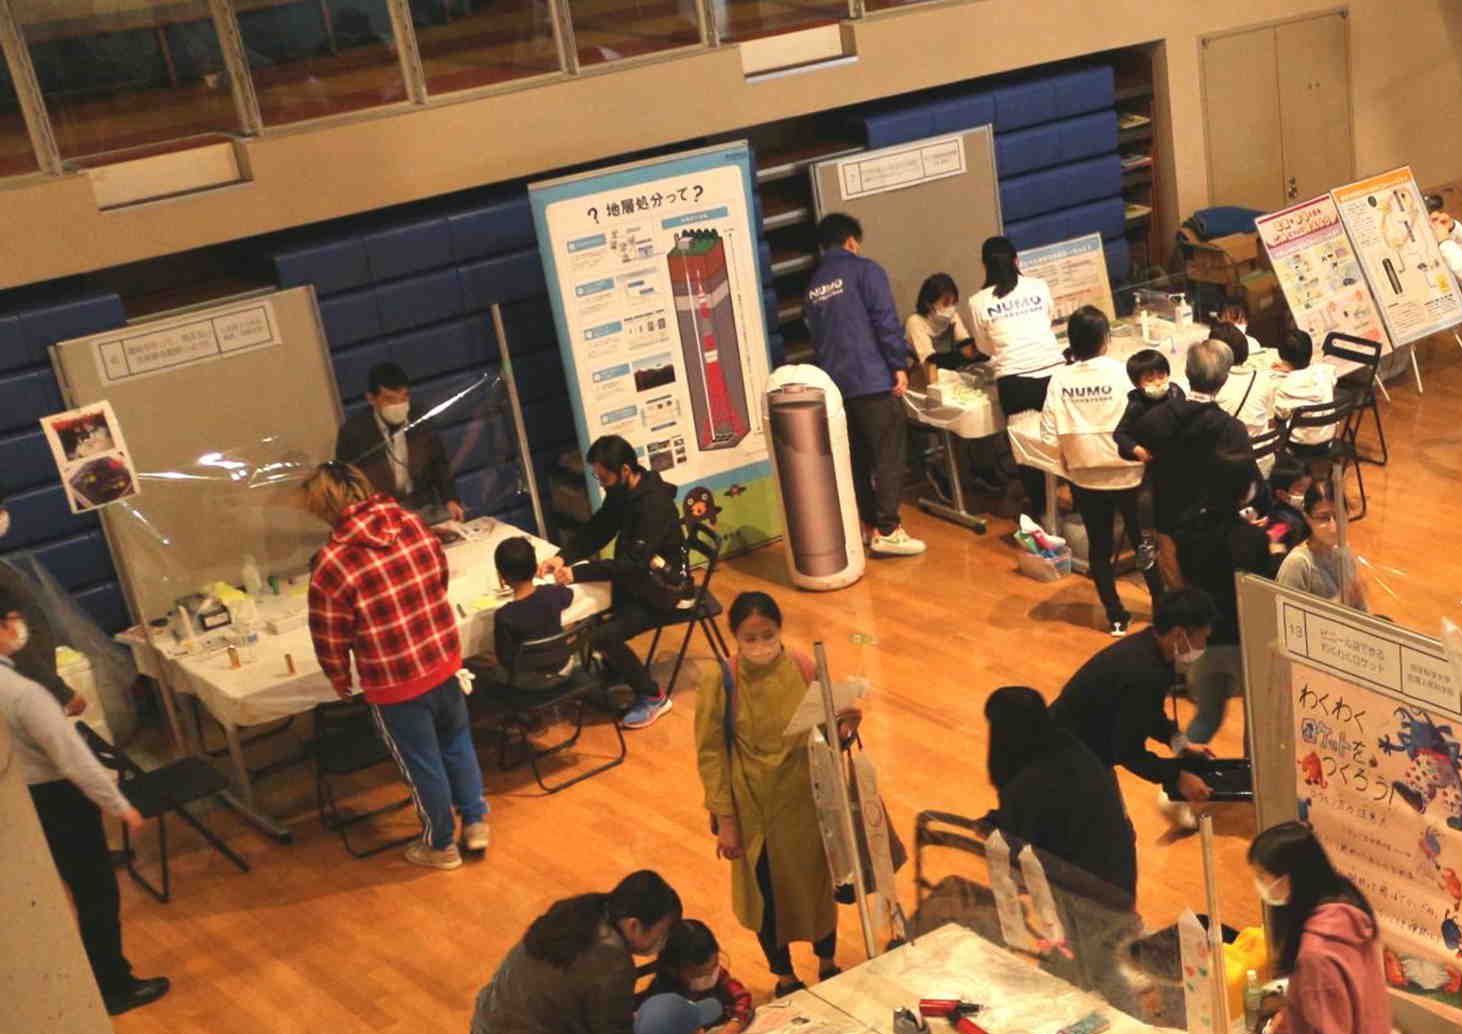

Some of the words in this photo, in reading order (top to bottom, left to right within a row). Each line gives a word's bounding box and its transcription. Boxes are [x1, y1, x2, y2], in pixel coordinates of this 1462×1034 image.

[986, 296, 1041, 317] NUMO
[1061, 383, 1113, 400] NUMO
[1299, 684, 1367, 733] わくわく
